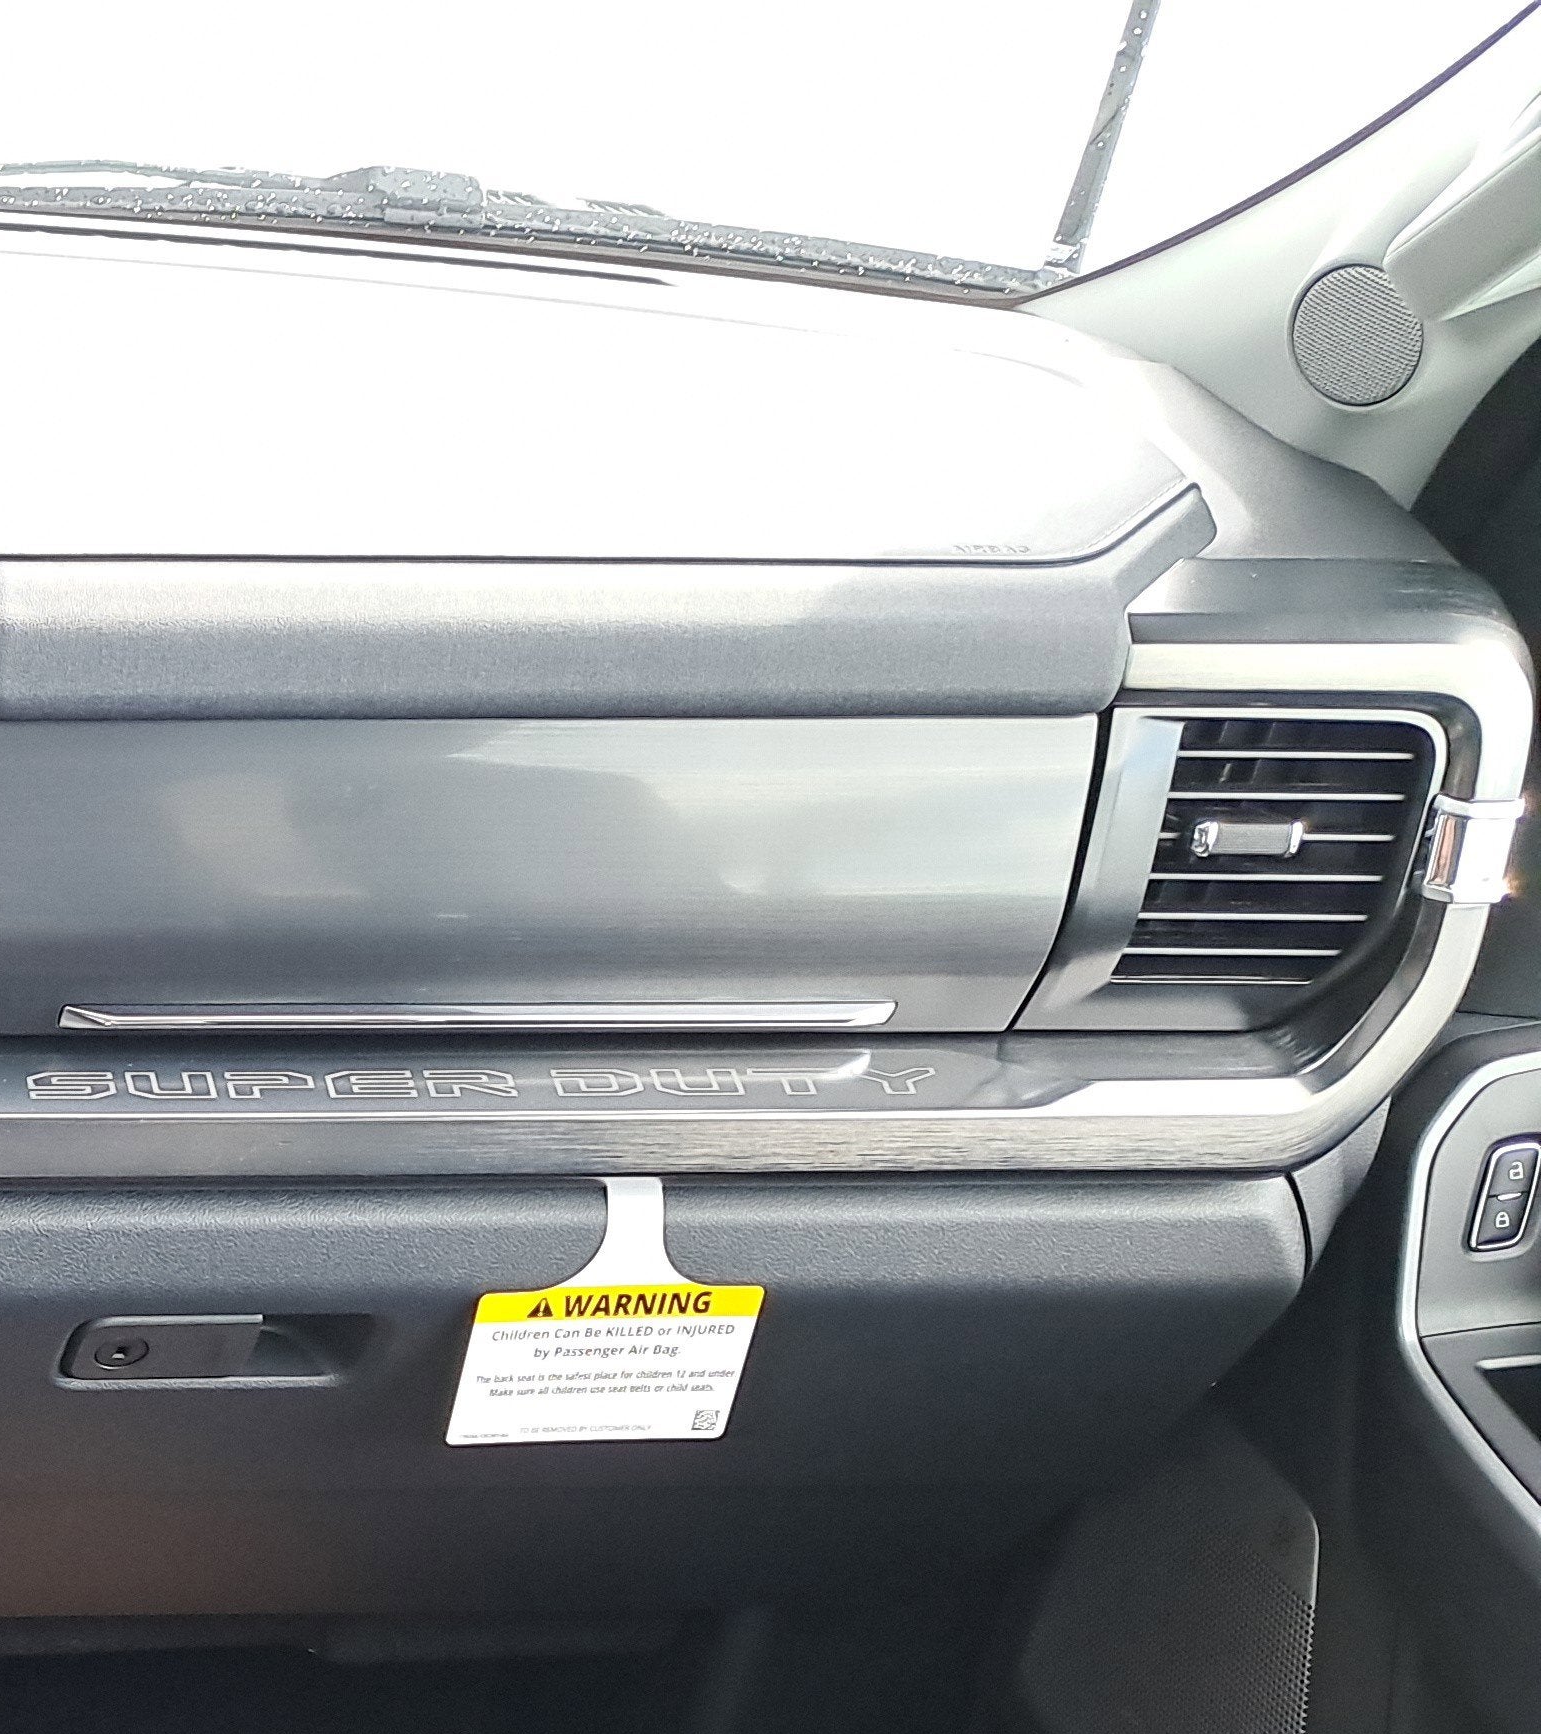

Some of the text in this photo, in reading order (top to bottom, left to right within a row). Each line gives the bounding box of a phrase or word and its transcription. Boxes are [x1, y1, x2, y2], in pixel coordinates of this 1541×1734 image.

[26, 1066, 937, 1101] SUPER DUTY
[563, 1291, 713, 1318] WARNING
[492, 1324, 736, 1341] Children Can Be KILLED or INJURED
[533, 1346, 549, 1360] by
[554, 1345, 624, 1359] Passenger
[628, 1345, 649, 1355] Air
